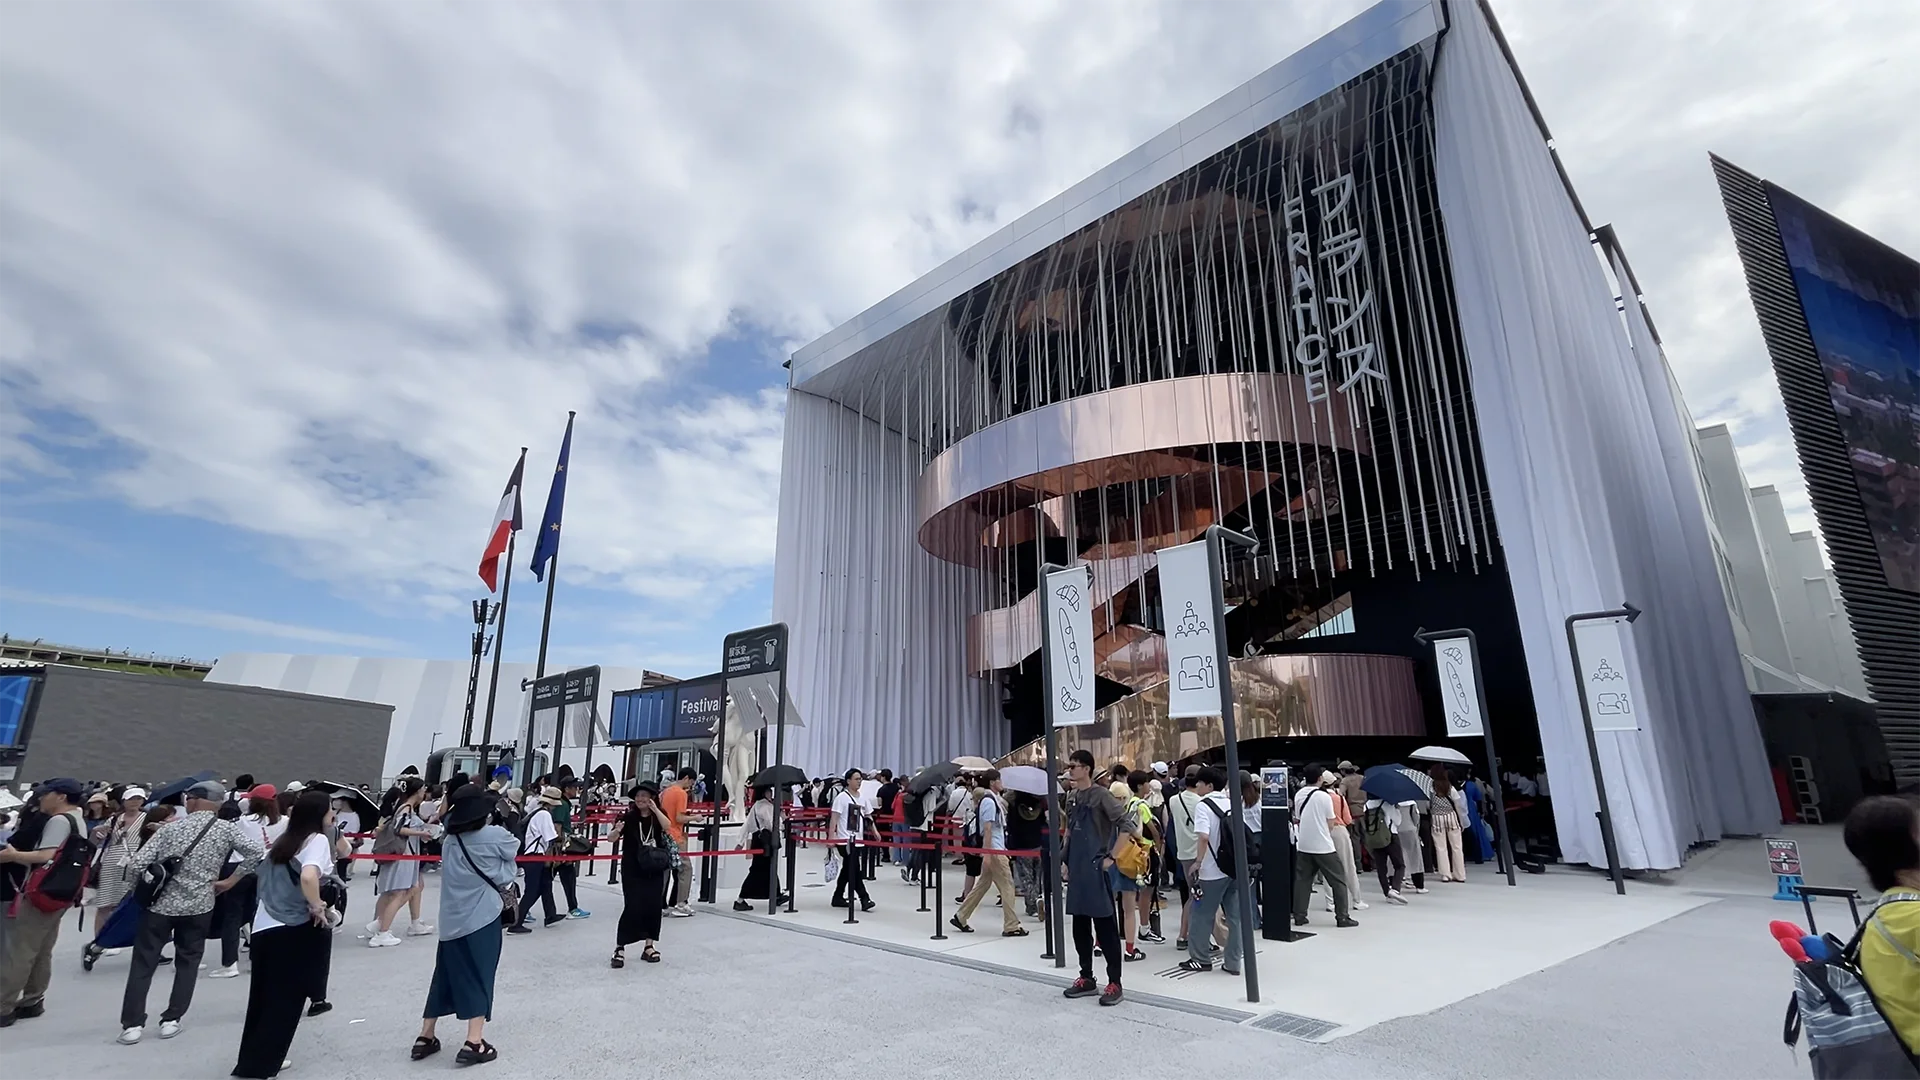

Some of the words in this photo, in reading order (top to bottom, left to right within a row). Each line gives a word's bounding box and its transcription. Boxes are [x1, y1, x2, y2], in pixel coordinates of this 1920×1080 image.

[1311, 173, 1387, 394] フランス
[681, 696, 721, 714] Festival
